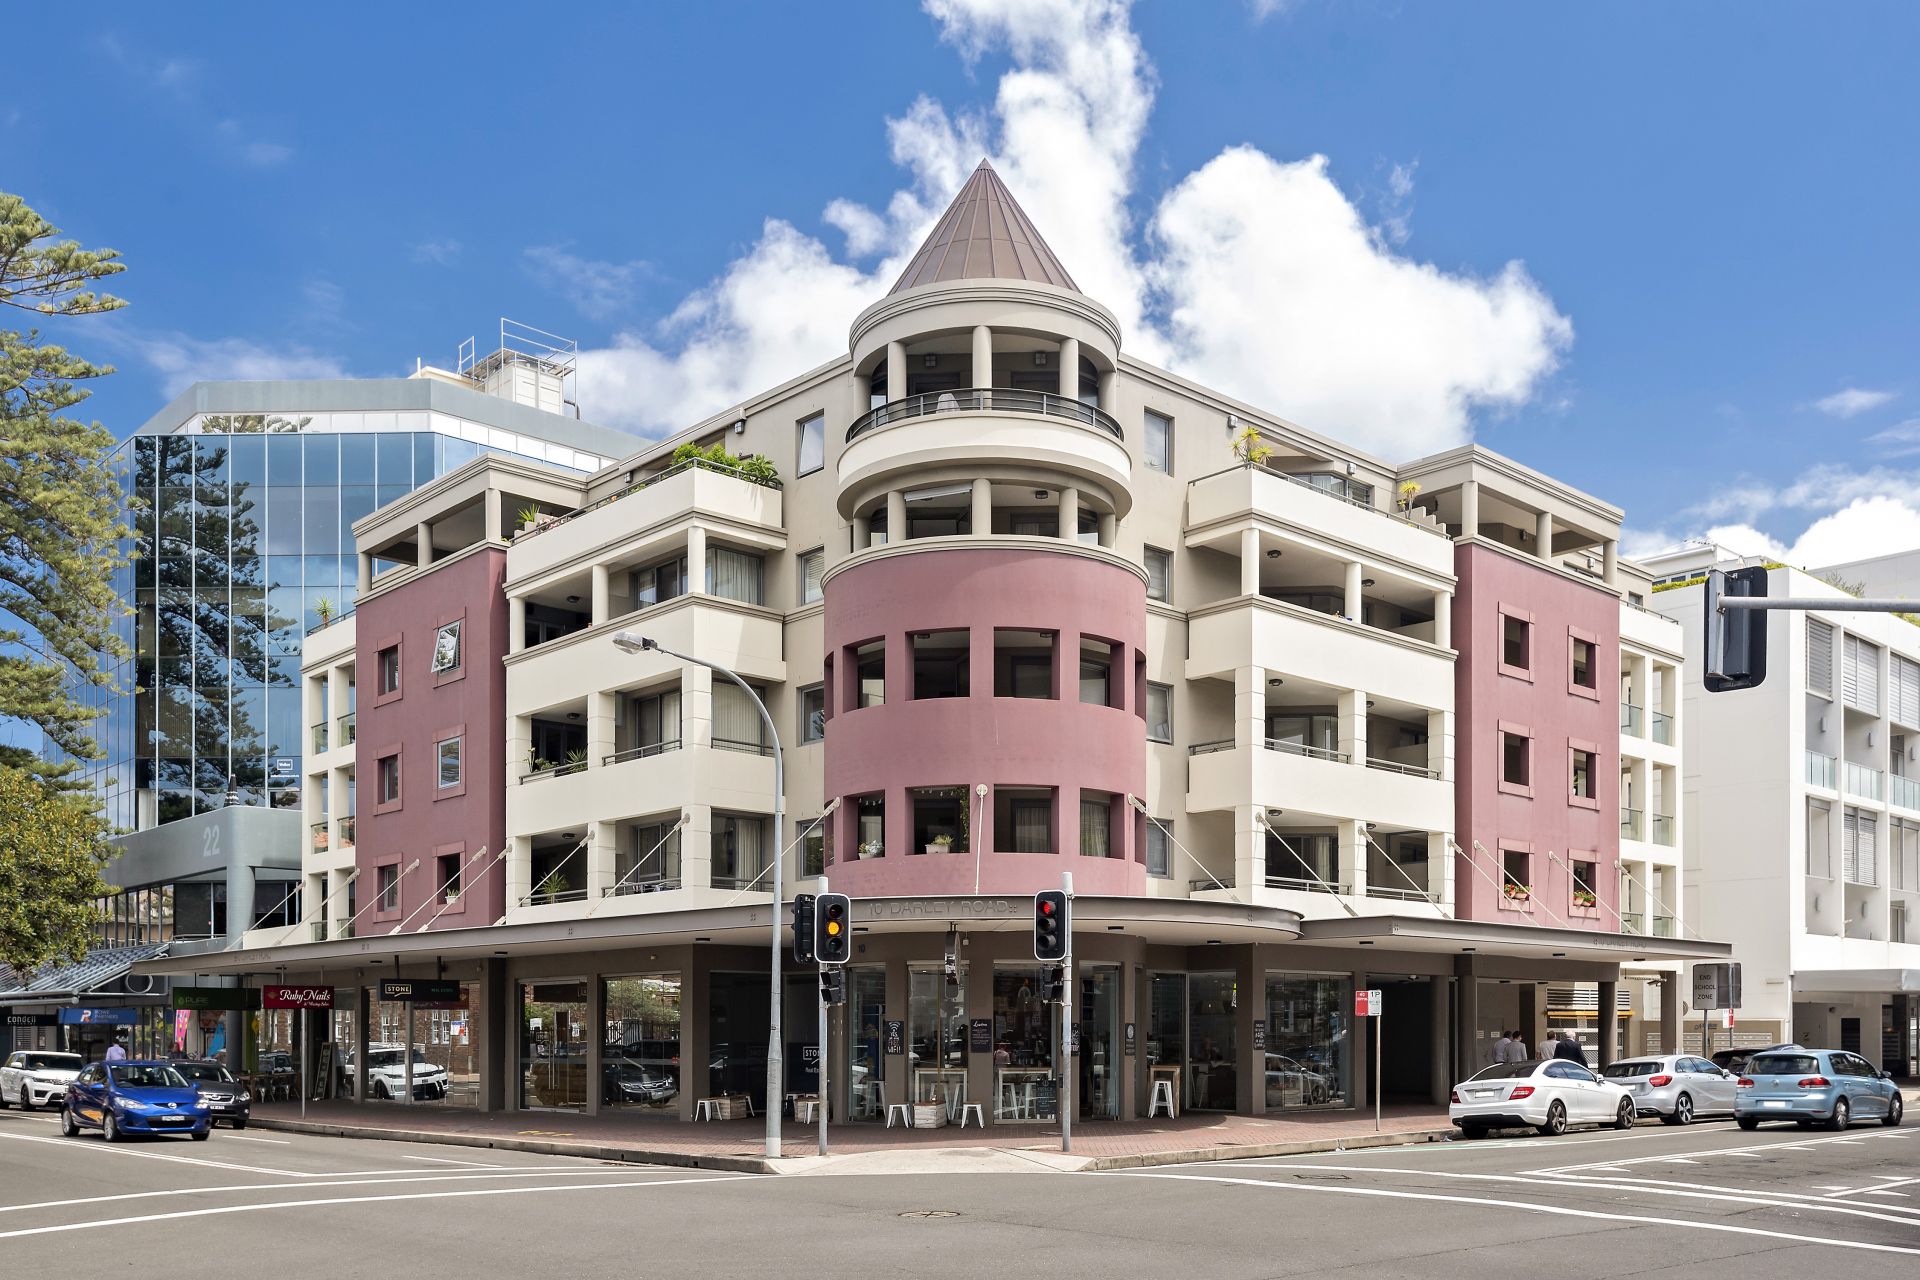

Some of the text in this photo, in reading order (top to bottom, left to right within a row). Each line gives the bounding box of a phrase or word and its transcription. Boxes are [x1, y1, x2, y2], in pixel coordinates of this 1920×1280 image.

[203, 825, 220, 857] 22
[868, 900, 1008, 915] 10 DARLEY ROAD
[280, 989, 331, 1004] Ruby Nails
